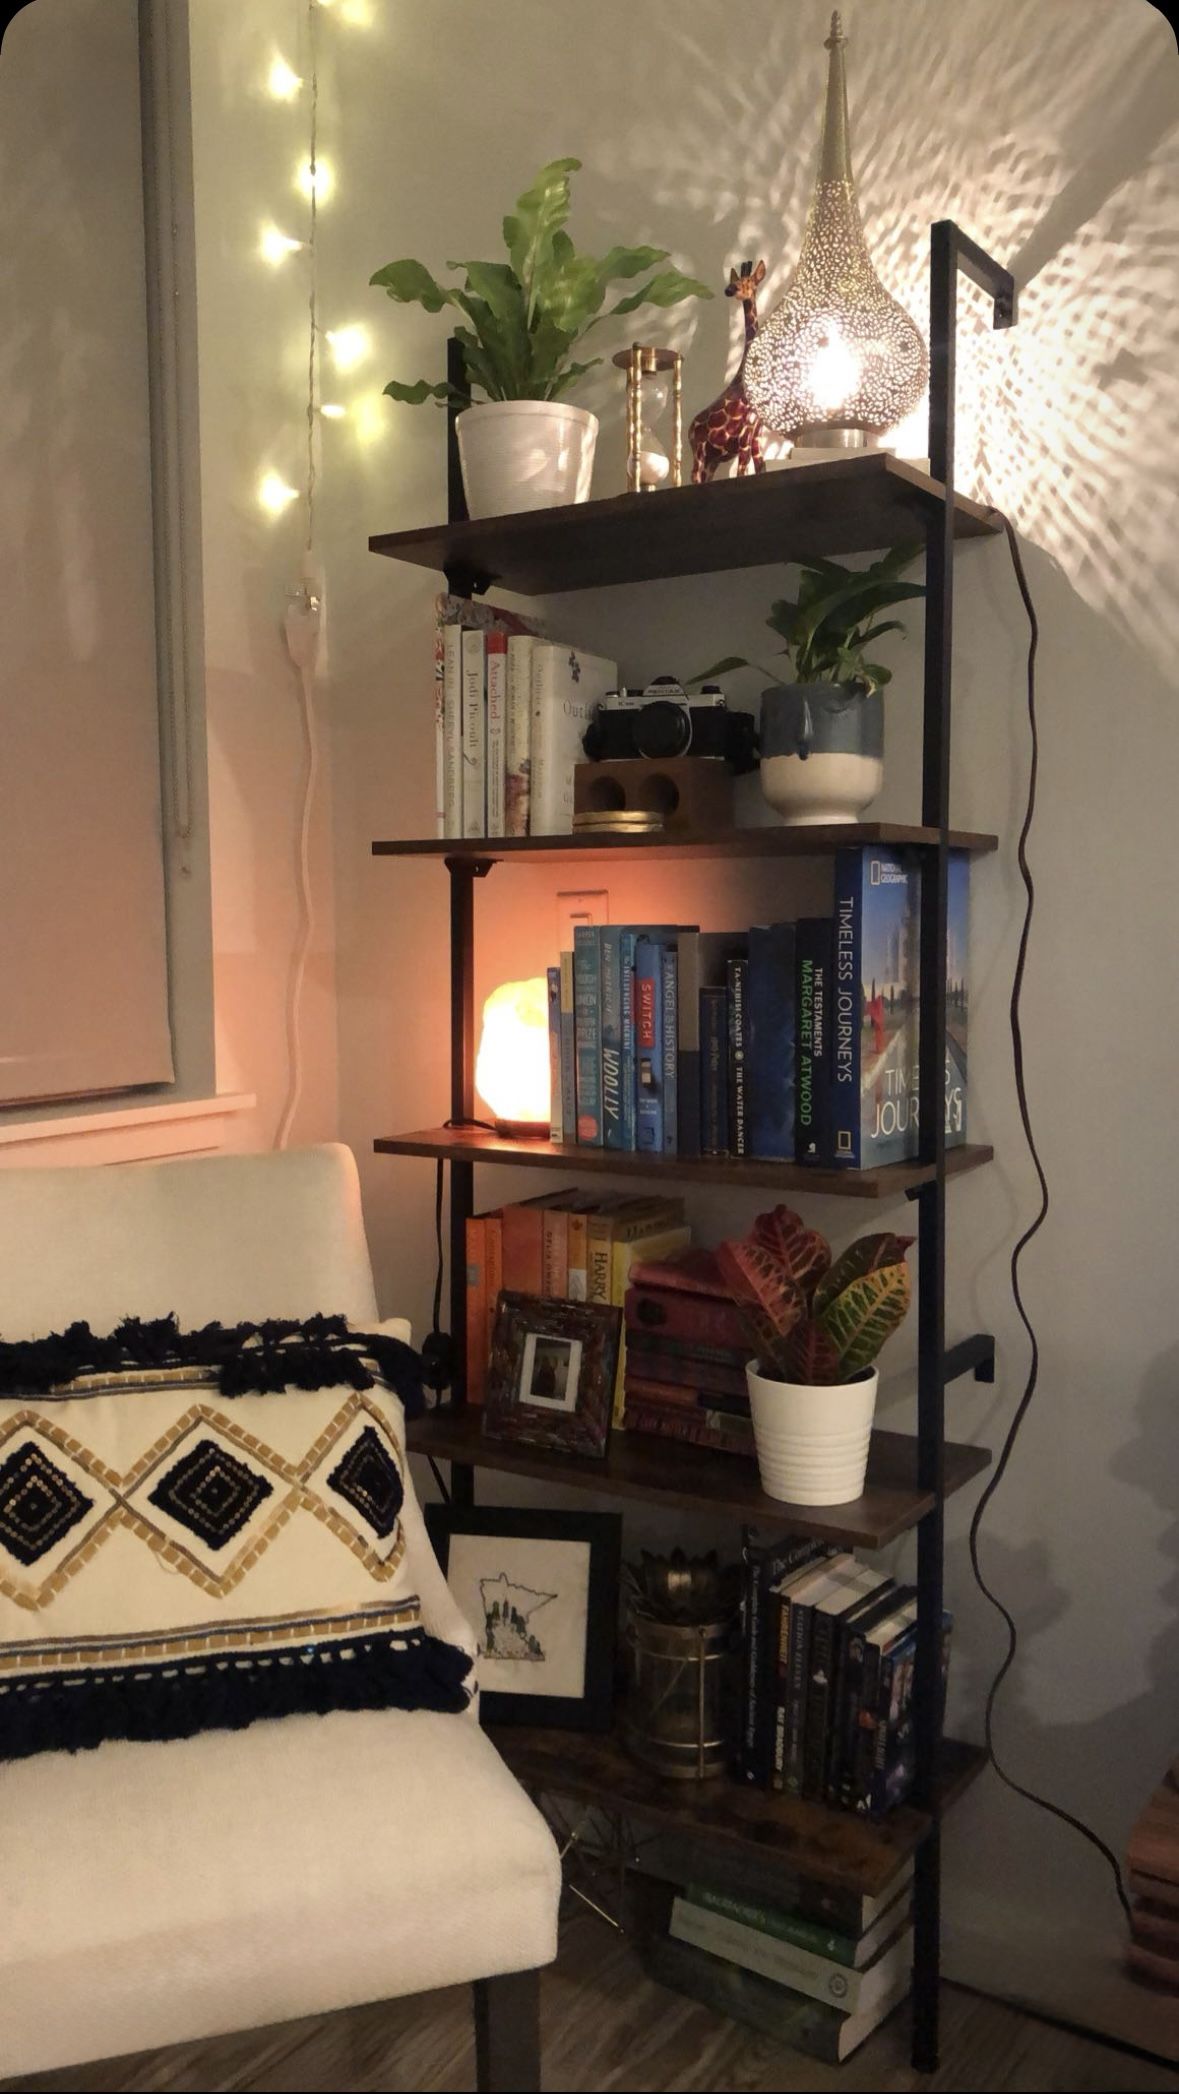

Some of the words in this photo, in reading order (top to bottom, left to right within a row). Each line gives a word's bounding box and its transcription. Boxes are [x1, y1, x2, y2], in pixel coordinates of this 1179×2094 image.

[465, 669, 479, 698] Jodi
[490, 660, 502, 720] Attached
[838, 896, 854, 981] TIMELESS
[664, 971, 675, 1012] ANGEL
[734, 967, 742, 1012] TA-NEHISI
[814, 967, 823, 987] THE
[641, 983, 652, 1040] SWITCH
[800, 959, 813, 1049] MARGARET
[813, 991, 823, 1057] TESTAMENTS
[664, 1025, 675, 1079] HISTORY
[734, 1013, 743, 1048] COATES
[836, 987, 853, 1083] JOURNEYS
[603, 1047, 620, 1120] WOOLLY
[736, 1085, 744, 1117] WATER
[800, 1055, 813, 1126] ATWOOD
[737, 1119, 745, 1155] DANCER
[870, 1087, 963, 1139] JOURYS
[593, 1252, 608, 1301] HARRY
[776, 1705, 785, 1723] RAY
[775, 1724, 784, 1772] BRADBURY
